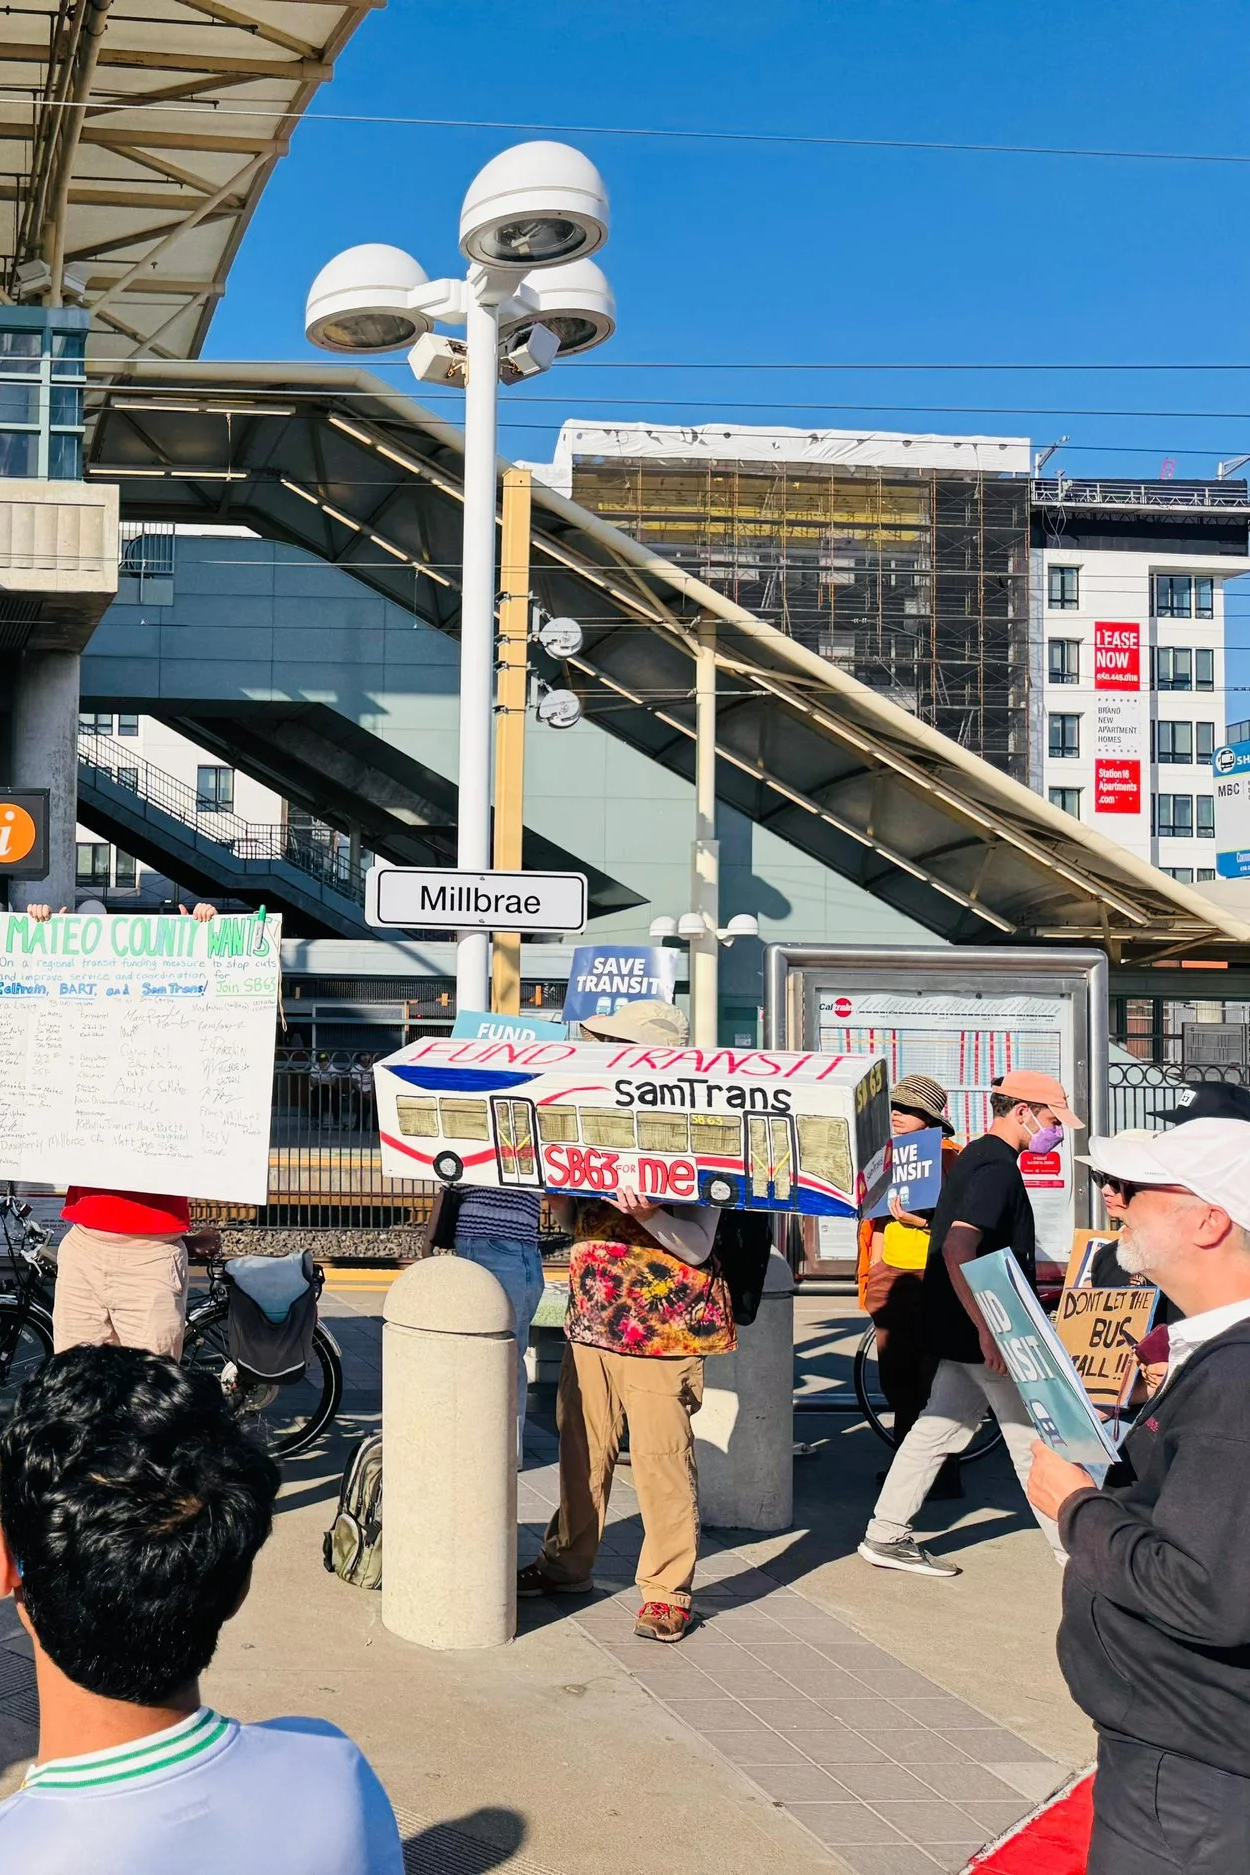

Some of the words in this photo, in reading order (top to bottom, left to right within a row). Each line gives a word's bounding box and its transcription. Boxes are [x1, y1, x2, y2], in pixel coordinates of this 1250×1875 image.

[1096, 630, 1138, 649] LEASE
[1096, 650, 1129, 668] NOW
[1098, 707, 1121, 715] BRAND
[1098, 726, 1137, 735] APARTMENT
[1098, 781, 1137, 793] Apartments
[1218, 783, 1240, 797] MBC
[1098, 795, 1115, 804] .com
[420, 886, 541, 914] Millbrae
[6, 915, 103, 955] MATEO
[111, 917, 201, 957] COUNTY
[207, 917, 273, 959] WANTS
[0, 957, 14, 967] On
[22, 960, 29, 968] a
[37, 958, 75, 971] regional
[82, 957, 116, 968] transit
[122, 957, 156, 970] funding
[162, 959, 205, 968] measure
[213, 958, 222, 968] to
[226, 957, 249, 971] stop
[255, 958, 277, 968] cuts
[592, 958, 646, 976] SAVE
[21, 973, 63, 985] improve
[70, 973, 110, 982] service
[116, 970, 133, 980] and
[136, 970, 207, 980] coordination
[214, 969, 231, 981] for
[215, 979, 239, 993] Join
[245, 976, 277, 993] SB63
[577, 976, 661, 995] TRANSIT
[105, 983, 130, 996] and
[476, 1023, 537, 1041] FUND
[408, 1041, 577, 1065] FUND
[606, 1045, 867, 1080] TRANSIT
[544, 1144, 620, 1190] SB63
[616, 1164, 636, 1174] FOR
[638, 1157, 696, 1196] me
[1063, 1291, 1103, 1319] DONT
[1103, 1291, 1128, 1311] LET
[1129, 1291, 1155, 1309] THE
[1089, 1316, 1132, 1348] BUS
